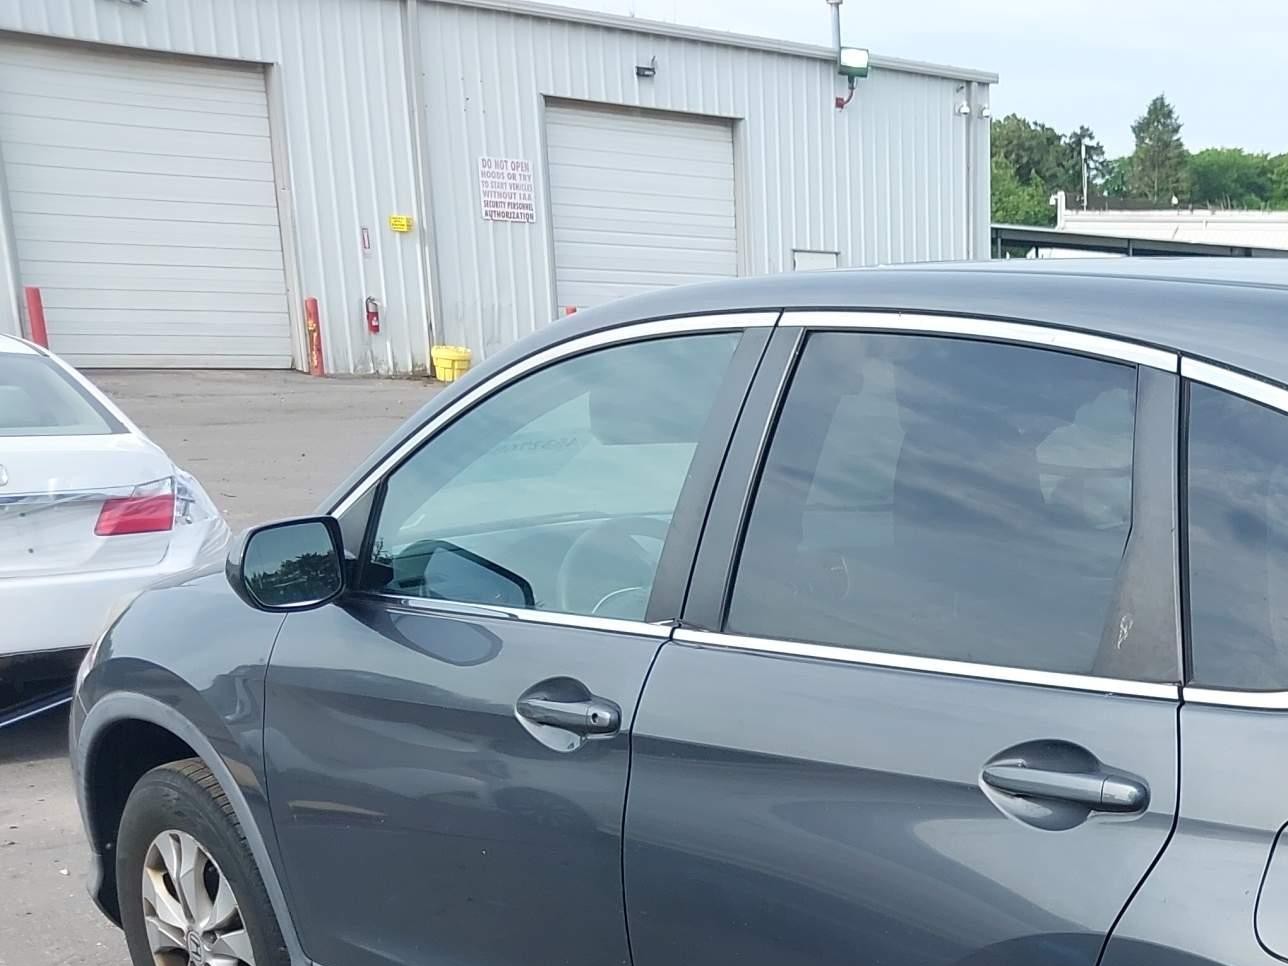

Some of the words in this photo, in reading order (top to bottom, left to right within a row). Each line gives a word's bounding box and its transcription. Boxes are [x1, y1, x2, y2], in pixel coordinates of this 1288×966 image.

[481, 158, 491, 169] DO
[494, 159, 508, 170] NOT
[510, 160, 529, 172] OPEN
[481, 170, 505, 180] HOODS
[507, 172, 516, 181] OR
[519, 173, 531, 182] TRY
[482, 180, 489, 188] TO
[490, 181, 507, 190] START
[509, 182, 532, 192] VEHICLES
[483, 190, 516, 200] WITHOUT
[483, 199, 506, 208] SECURITY
[507, 201, 533, 211] PERSONNEL
[484, 209, 534, 221] AUTHORIZATION
